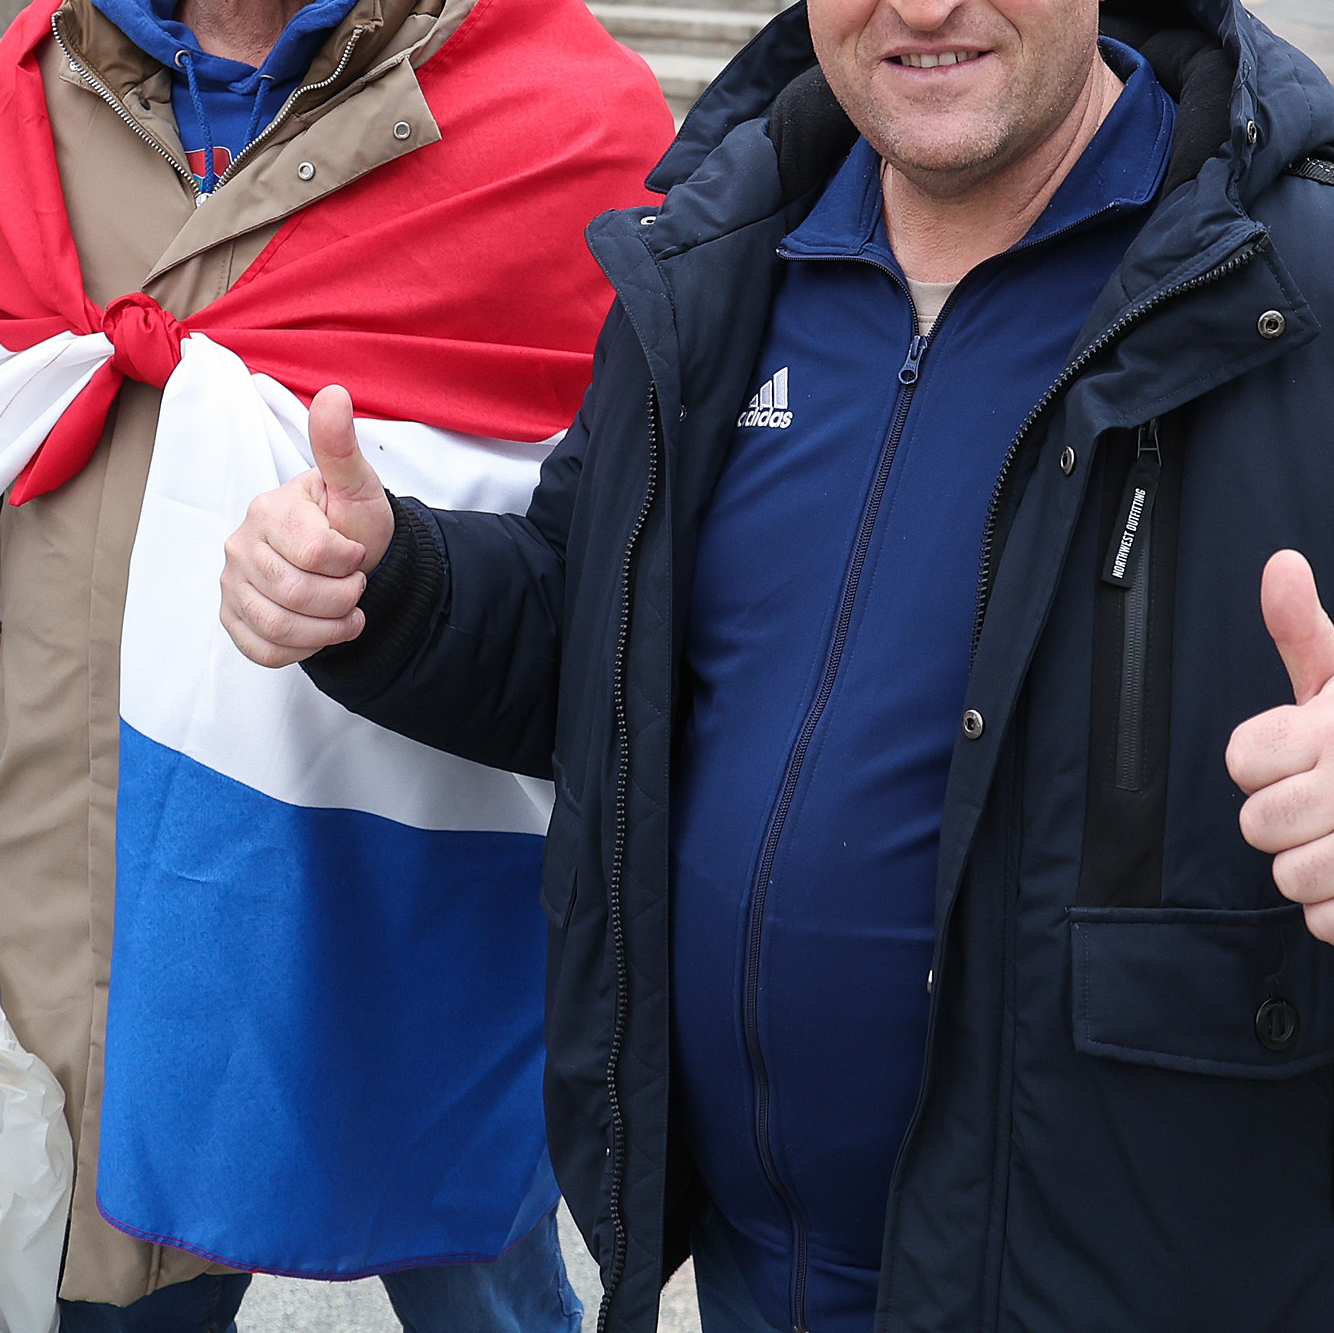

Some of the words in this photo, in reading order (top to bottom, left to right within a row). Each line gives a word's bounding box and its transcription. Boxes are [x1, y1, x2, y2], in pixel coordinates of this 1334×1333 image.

[737, 407, 794, 429] adidas
[1112, 530, 1135, 579] NORTHWEST
[1125, 487, 1147, 532] OUTFITTING
